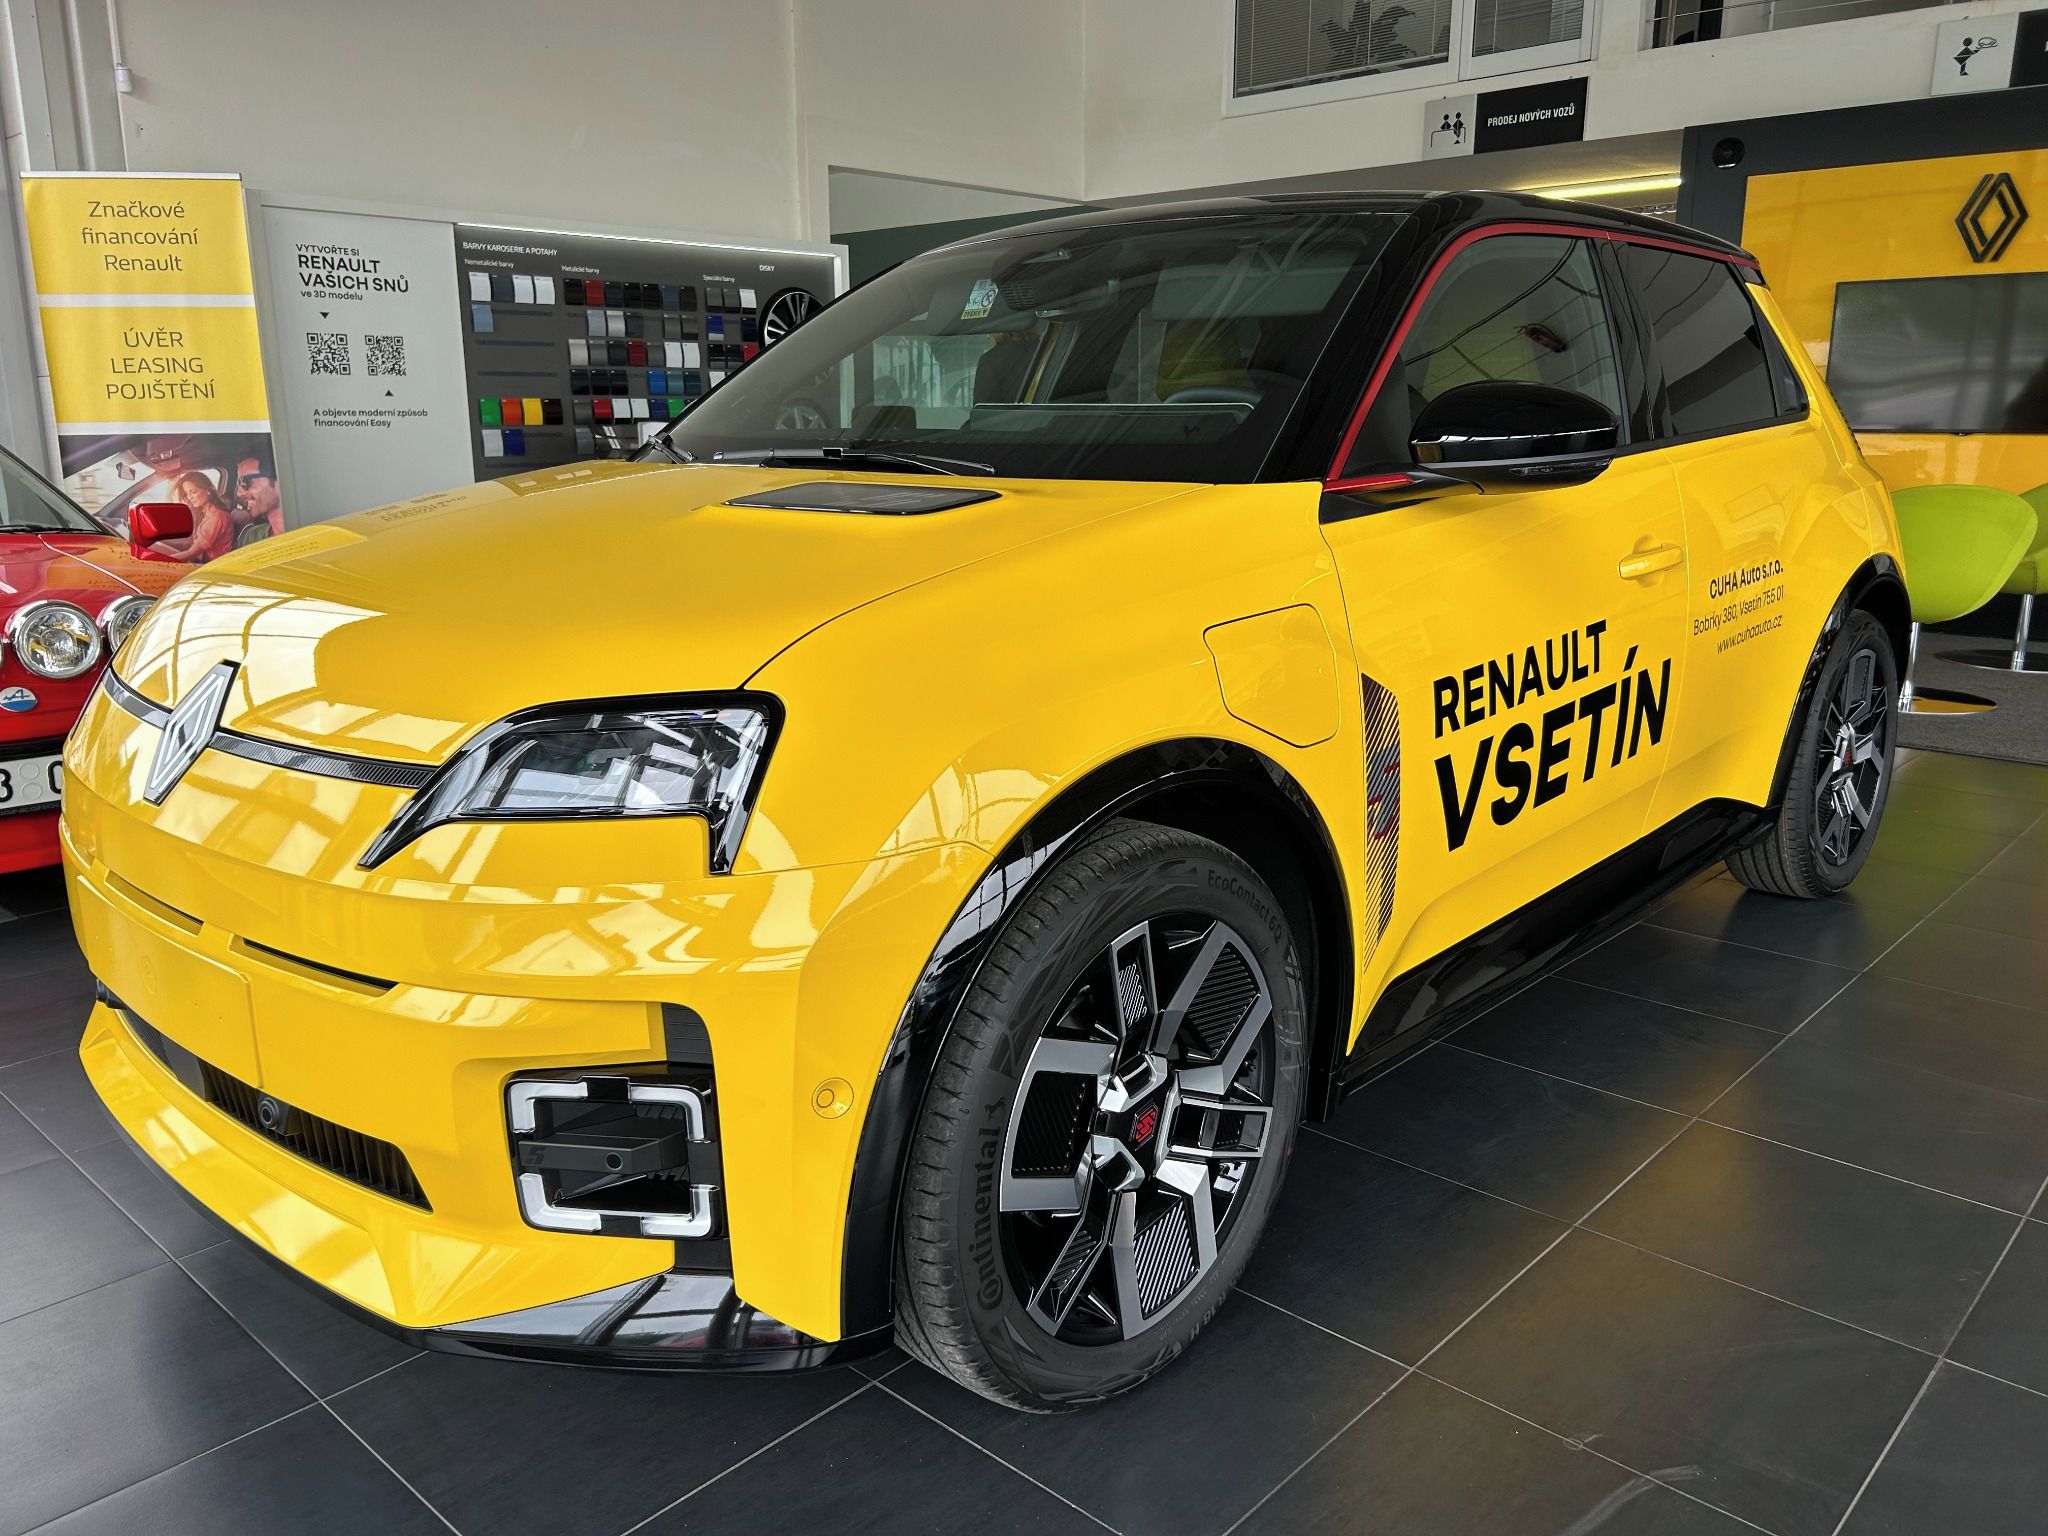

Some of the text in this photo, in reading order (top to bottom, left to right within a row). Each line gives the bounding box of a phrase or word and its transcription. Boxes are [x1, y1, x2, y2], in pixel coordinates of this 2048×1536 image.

[1487, 102, 1575, 127] PRODEJ NOVÝCH VOZŮ
[87, 200, 185, 218] Značkové
[81, 227, 198, 245] financování
[295, 243, 360, 257] VYTVOŘTE SI
[462, 241, 486, 251] BARVY
[487, 243, 525, 254] KAROSERIE
[531, 247, 558, 256] POTAHY
[103, 254, 183, 271] Renault
[297, 254, 381, 274] RENAULT
[498, 260, 515, 269] barvy
[585, 267, 600, 275] barvy
[298, 270, 409, 293] VAŠICH SNŮ
[300, 290, 363, 301] ve 3D modelu
[123, 327, 184, 348] ÚVĚR
[110, 357, 204, 374] LEASING
[106, 378, 215, 400] POJIŠTĚNÍ
[313, 407, 428, 418] A objevte moderní způsob
[313, 418, 392, 428] financování Easy
[1709, 559, 1784, 599] CUHA Auto s.r.o.
[1693, 584, 1784, 636] Bobrky 380, Vsetín 755 01
[1717, 614, 1783, 654] www.cuhaauto.cz
[1433, 619, 1607, 739] RENAULT
[1434, 644, 1672, 852] VSETÍN
[1207, 869, 1269, 923] EcoContact
[969, 1127, 1003, 1311] Continental
